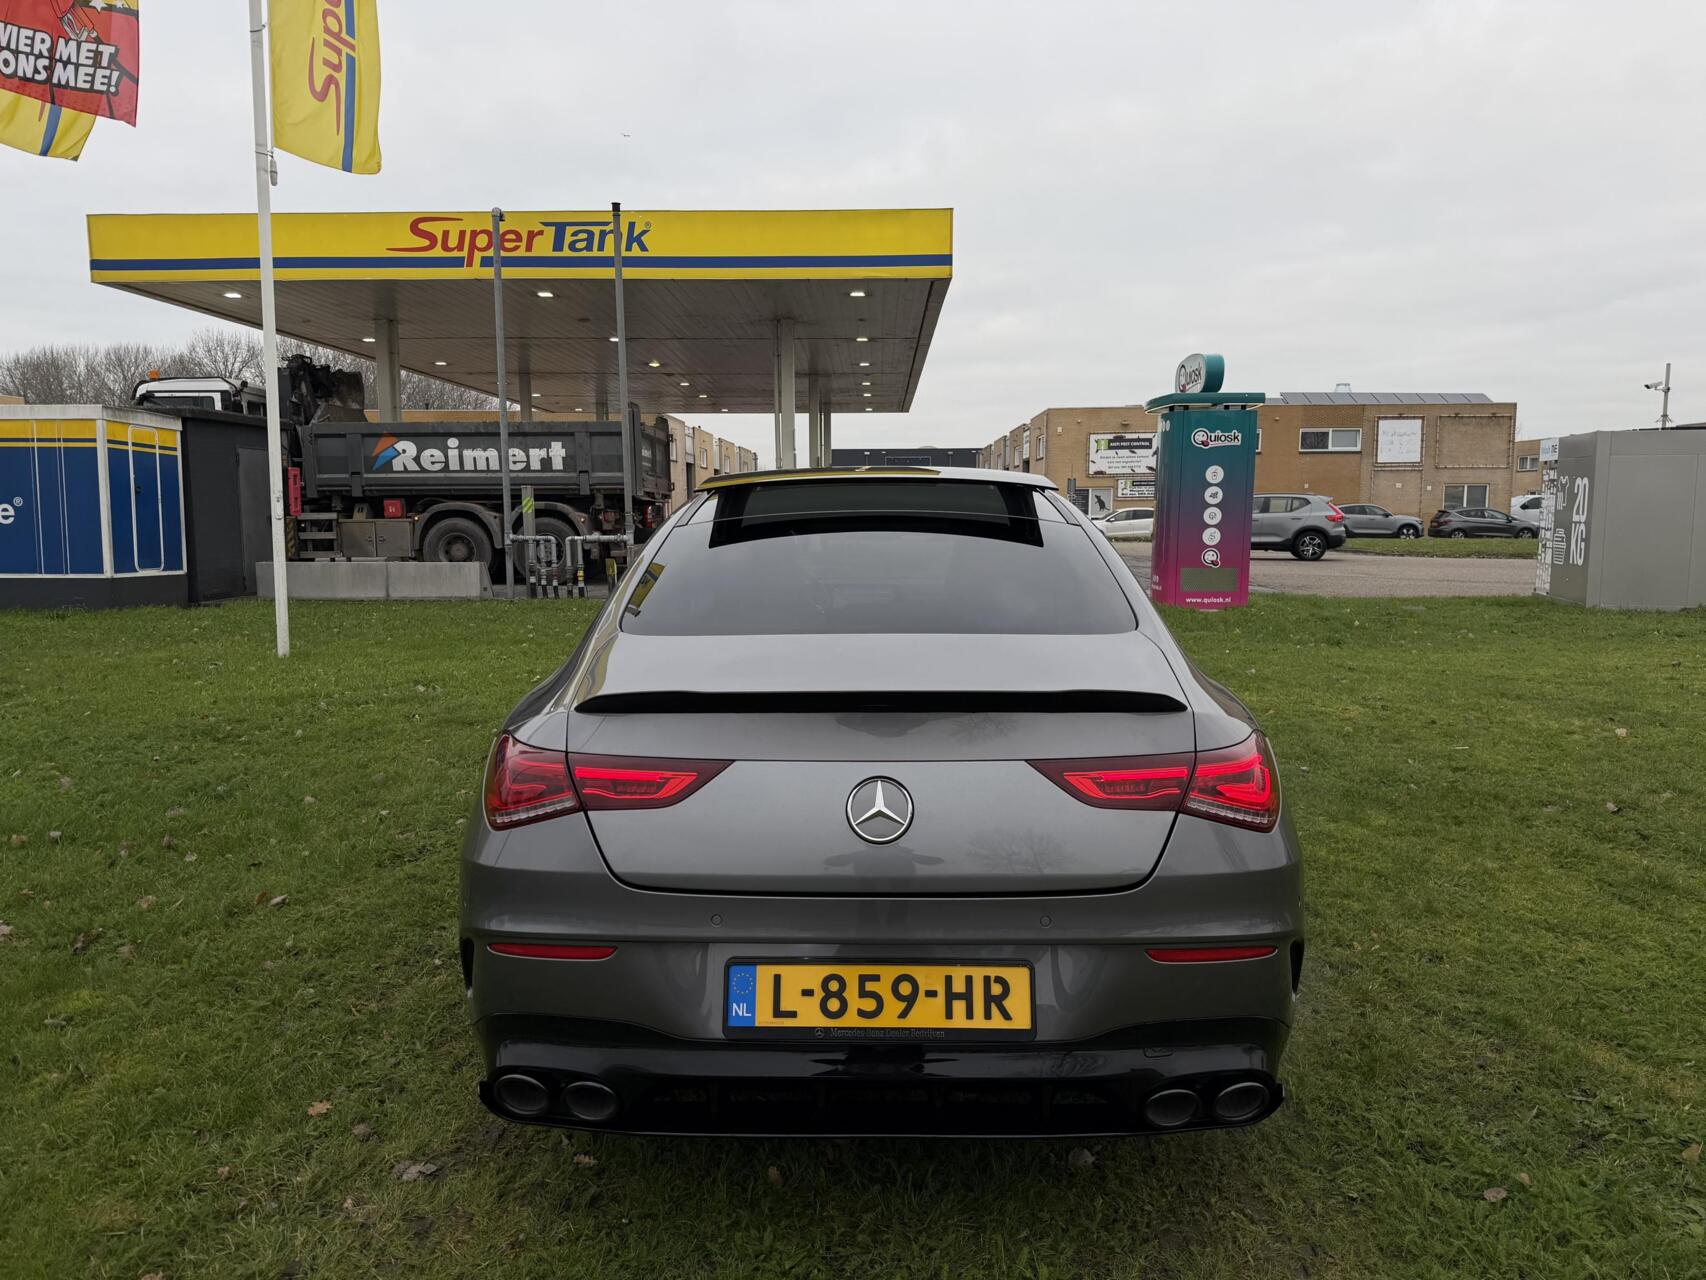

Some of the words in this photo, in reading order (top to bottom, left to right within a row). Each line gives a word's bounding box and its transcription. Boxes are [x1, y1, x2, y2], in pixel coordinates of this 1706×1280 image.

[54, 38, 116, 68] MET
[0, 50, 50, 81] ONS
[52, 63, 120, 93] MEE!
[392, 437, 566, 471] Reimert
[1192, 429, 1240, 447] Quiosk
[1572, 476, 1589, 523] 20
[1569, 523, 1586, 567] KG
[1185, 596, 1232, 604] www.quiosk.nl
[732, 1003, 752, 1018] NL
[772, 973, 1013, 1021] L-859-HR
